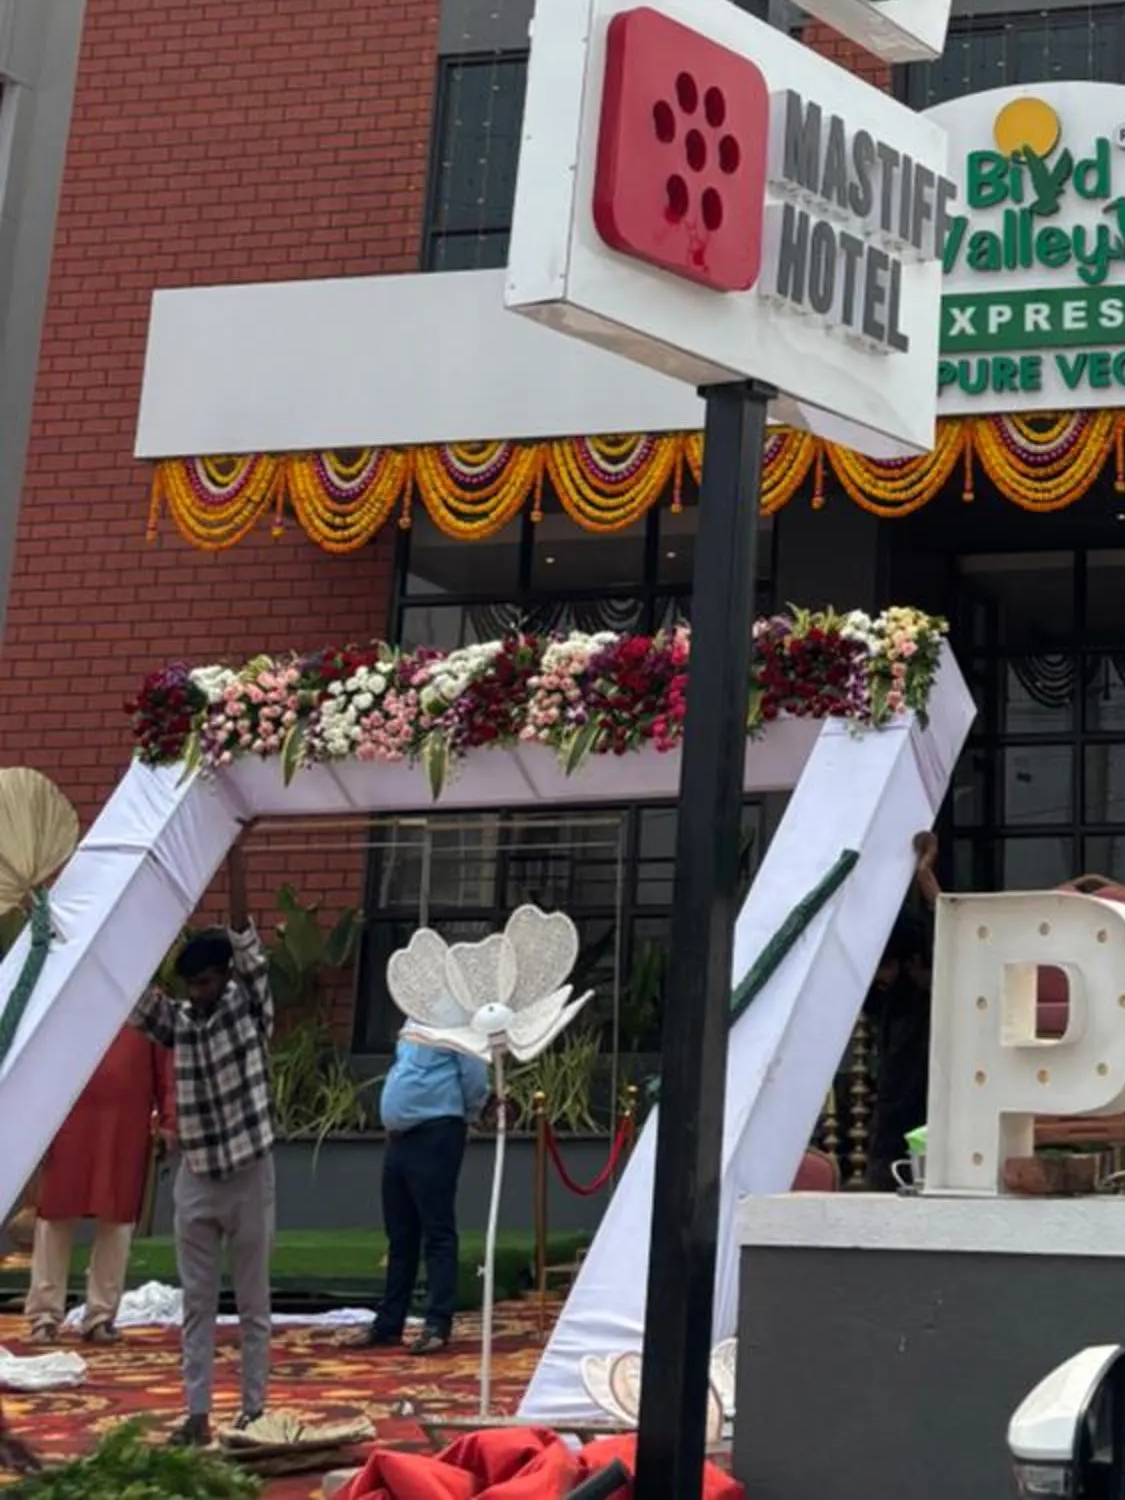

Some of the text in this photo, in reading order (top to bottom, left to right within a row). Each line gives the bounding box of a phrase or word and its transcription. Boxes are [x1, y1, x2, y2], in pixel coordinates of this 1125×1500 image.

[783, 88, 957, 260] MASTIFF
[776, 202, 909, 353] HOTEL
[937, 355, 1043, 397] PURE
